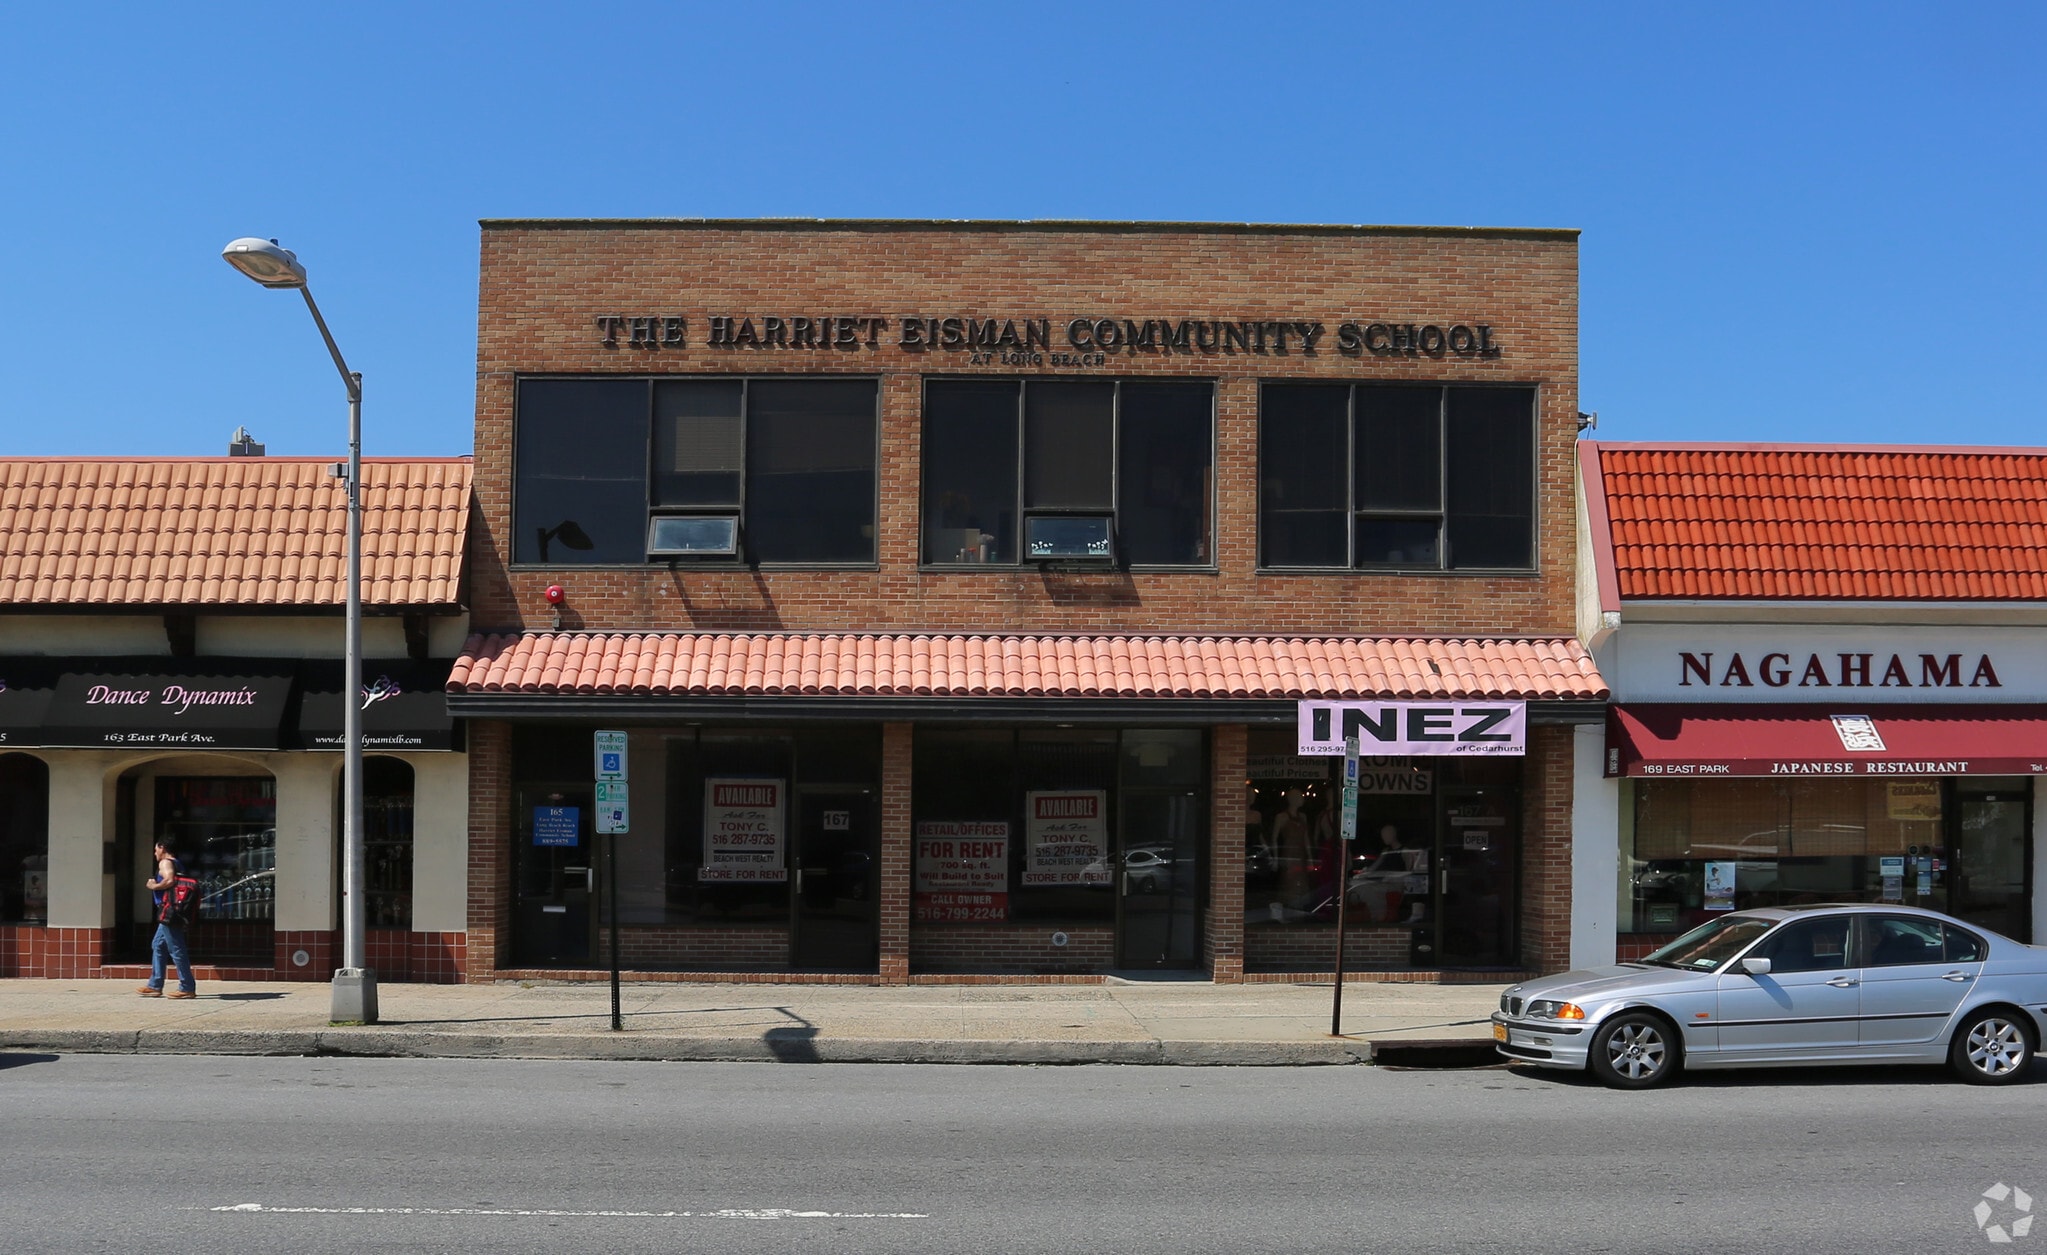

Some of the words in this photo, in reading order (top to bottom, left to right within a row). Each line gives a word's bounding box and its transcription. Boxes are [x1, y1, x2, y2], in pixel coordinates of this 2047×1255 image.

[598, 315, 684, 346] THE
[706, 316, 887, 348] HARRIET
[899, 316, 1050, 350] EISMAN
[1068, 318, 1323, 353] COMMUNITY
[1338, 321, 1499, 356] SCHOOL
[970, 351, 992, 365] AT
[1000, 351, 1042, 366] LONG
[1050, 351, 1105, 366] BEACH
[1678, 652, 2003, 688] NAGAHAMA
[86, 685, 151, 705] Dance
[160, 685, 257, 715] Dynamix
[1312, 708, 1512, 742] INEZ
[104, 733, 124, 743] 163
[127, 733, 156, 743] East
[158, 731, 188, 743] Park
[190, 733, 216, 743] Ave.
[1456, 744, 1467, 752] of
[1468, 744, 1523, 752] Cedarhurst
[1247, 756, 1284, 766] eautiful
[1287, 756, 1328, 766] Clothes
[1247, 768, 1284, 778] eautiful
[1287, 768, 1321, 778] Prices
[1643, 764, 1663, 774] 169
[1667, 764, 1697, 774] EAST
[1699, 764, 1730, 774] PARK
[1770, 761, 1855, 774] JAPANESE
[1866, 761, 1969, 774] RESTAURANT
[1341, 773, 1428, 791] OWNS
[598, 785, 606, 799] 2
[718, 787, 772, 805] AVAILABLE
[550, 808, 564, 816] 165
[1040, 798, 1094, 817] AVAILABLE
[723, 811, 744, 819] Ask
[746, 811, 766, 819] For
[824, 813, 849, 826] 167
[719, 822, 753, 832] TONY
[756, 822, 769, 832] C.
[919, 824, 1006, 836] RETAIL/OFFICES
[712, 834, 728, 845] 516
[730, 833, 775, 845] 287-9735
[1041, 834, 1076, 843] TONY
[1079, 834, 1092, 843] C.
[1465, 835, 1487, 845] OPEN
[920, 841, 954, 858] FOR
[959, 841, 1004, 858] RENT
[1035, 847, 1051, 857] 516
[1054, 845, 1099, 857] 287-9735
[713, 854, 734, 863] BEACH
[734, 854, 751, 863] WEST
[752, 854, 775, 863] REALTY
[1036, 858, 1057, 866] BEACH
[940, 861, 959, 869] 700
[980, 861, 991, 869] ft.
[701, 870, 732, 880] STORE
[736, 870, 756, 880] FOR
[759, 870, 785, 880] RENT
[920, 872, 939, 880] Will
[941, 872, 968, 880] Build
[971, 872, 982, 880] to
[983, 872, 1004, 880] Suit
[1025, 873, 1057, 882] STORE
[1061, 873, 1081, 881] FOR
[1084, 872, 1109, 881] RENT
[931, 895, 955, 905] CALL
[957, 895, 992, 904] OWNER
[918, 907, 1005, 920] 516-799-2244
